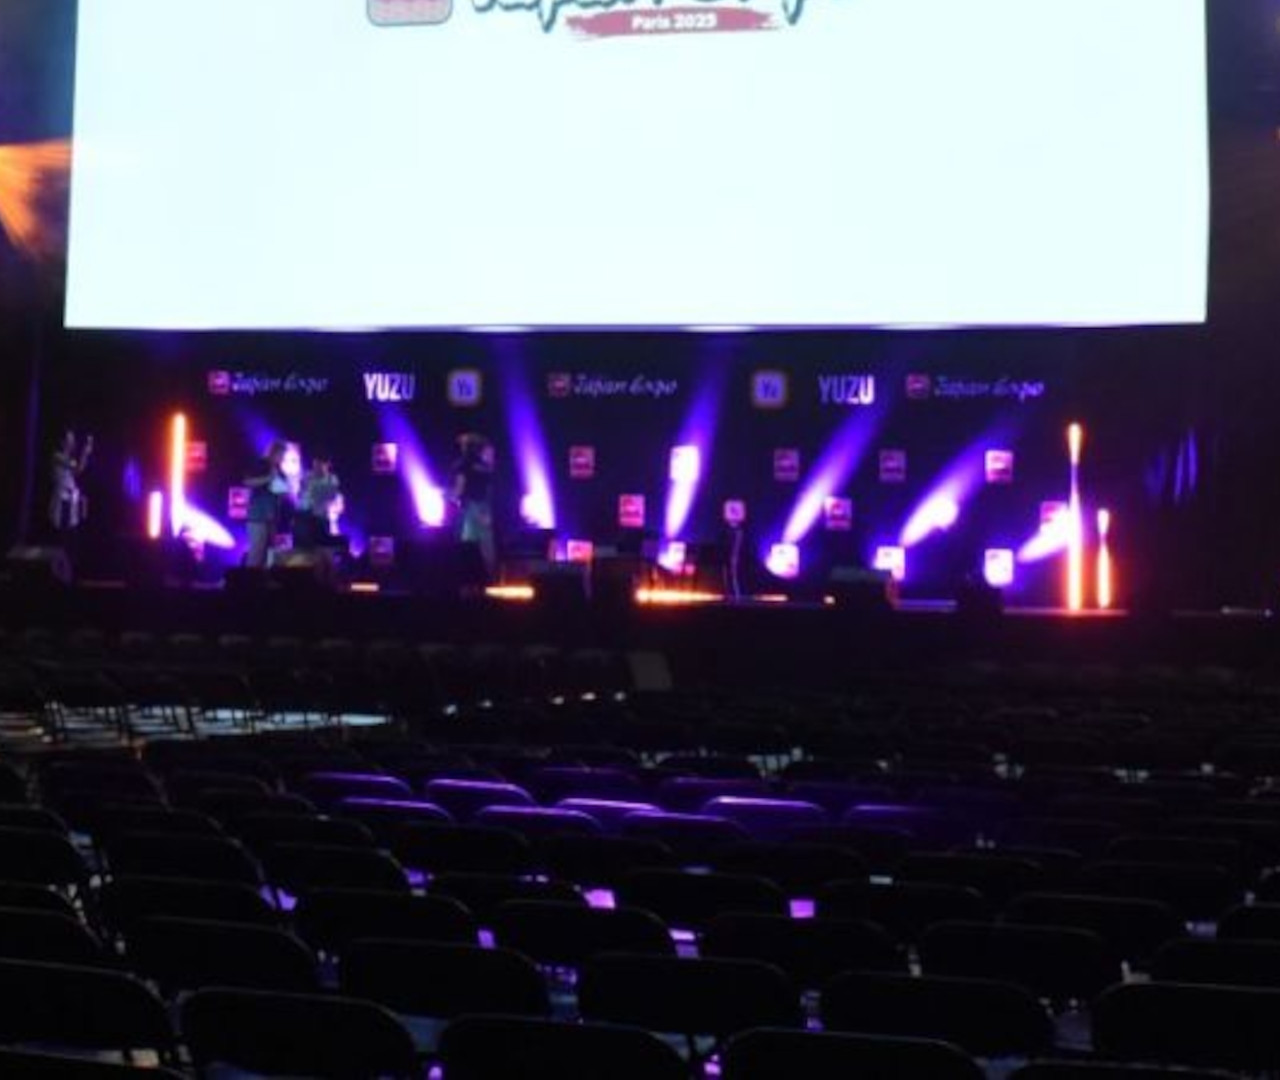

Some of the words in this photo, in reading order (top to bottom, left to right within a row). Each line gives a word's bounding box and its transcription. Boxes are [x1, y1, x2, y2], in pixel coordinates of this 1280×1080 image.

[632, 13, 671, 31] Paris
[363, 373, 415, 401] YUZU
[819, 374, 875, 404] YUZU
